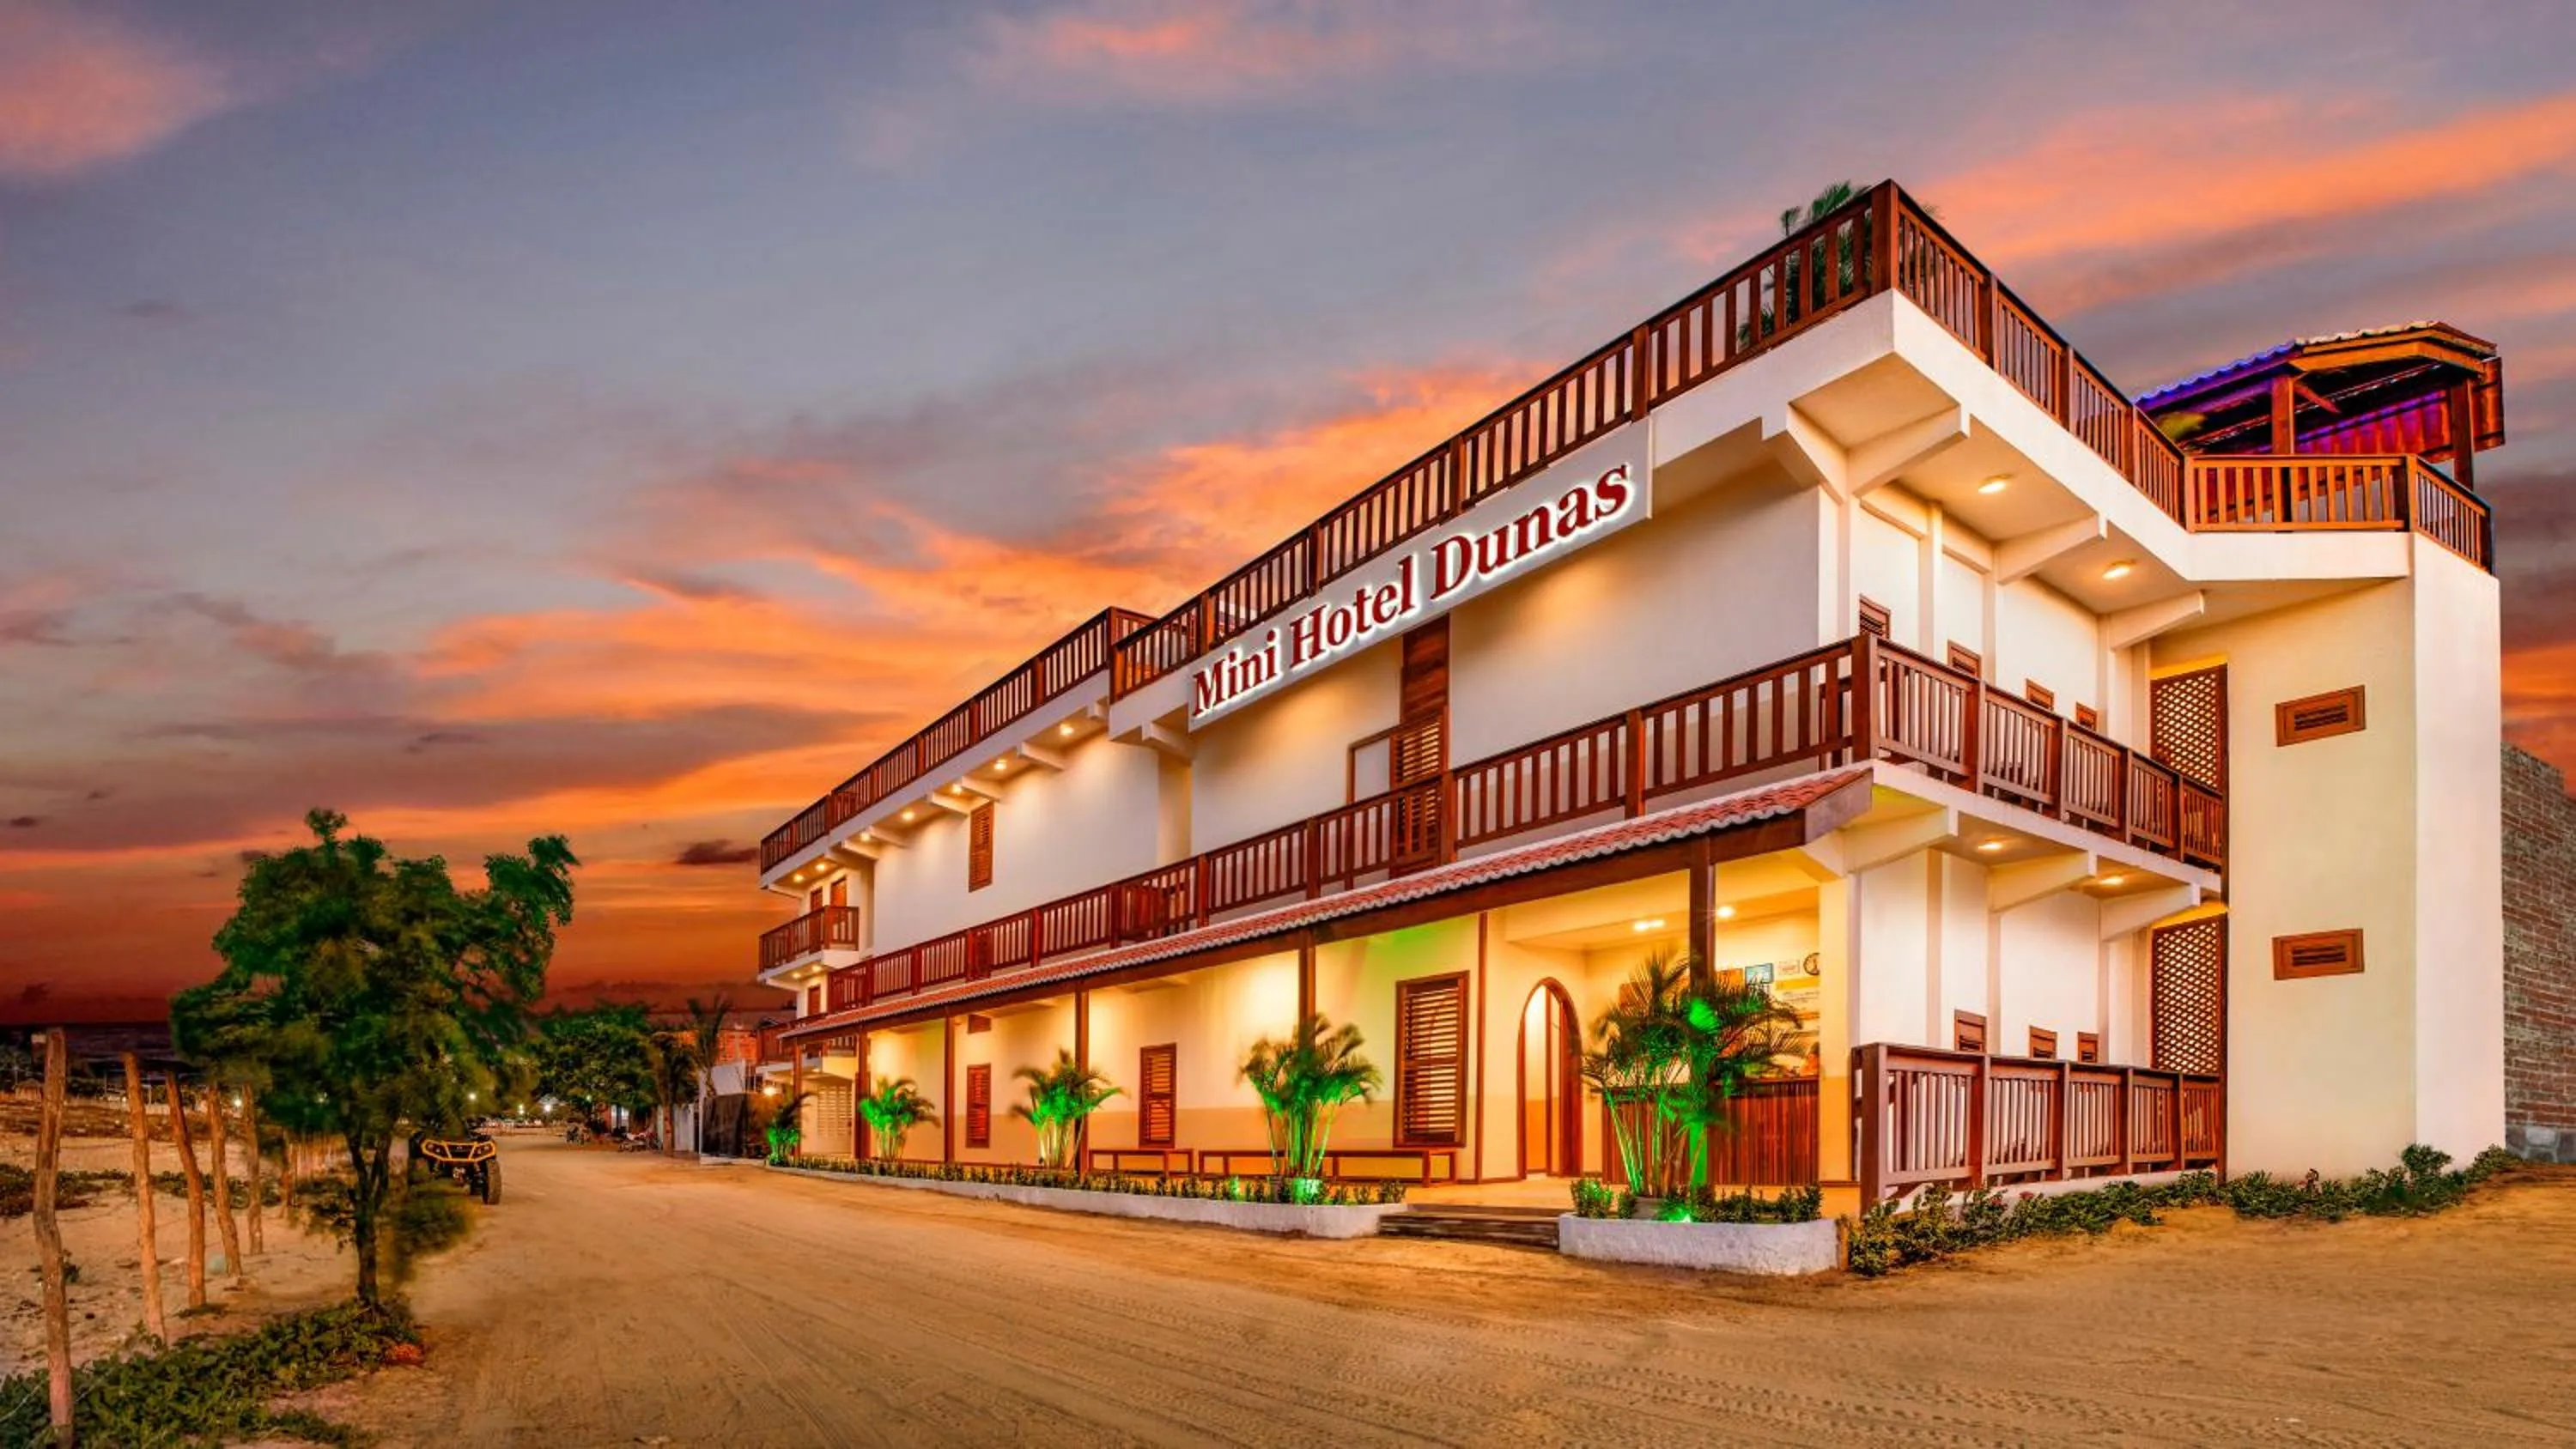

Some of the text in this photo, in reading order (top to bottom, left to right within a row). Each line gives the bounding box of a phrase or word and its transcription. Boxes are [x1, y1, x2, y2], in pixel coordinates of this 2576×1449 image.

[1192, 464, 1629, 718] Mini Hotel Dunas
